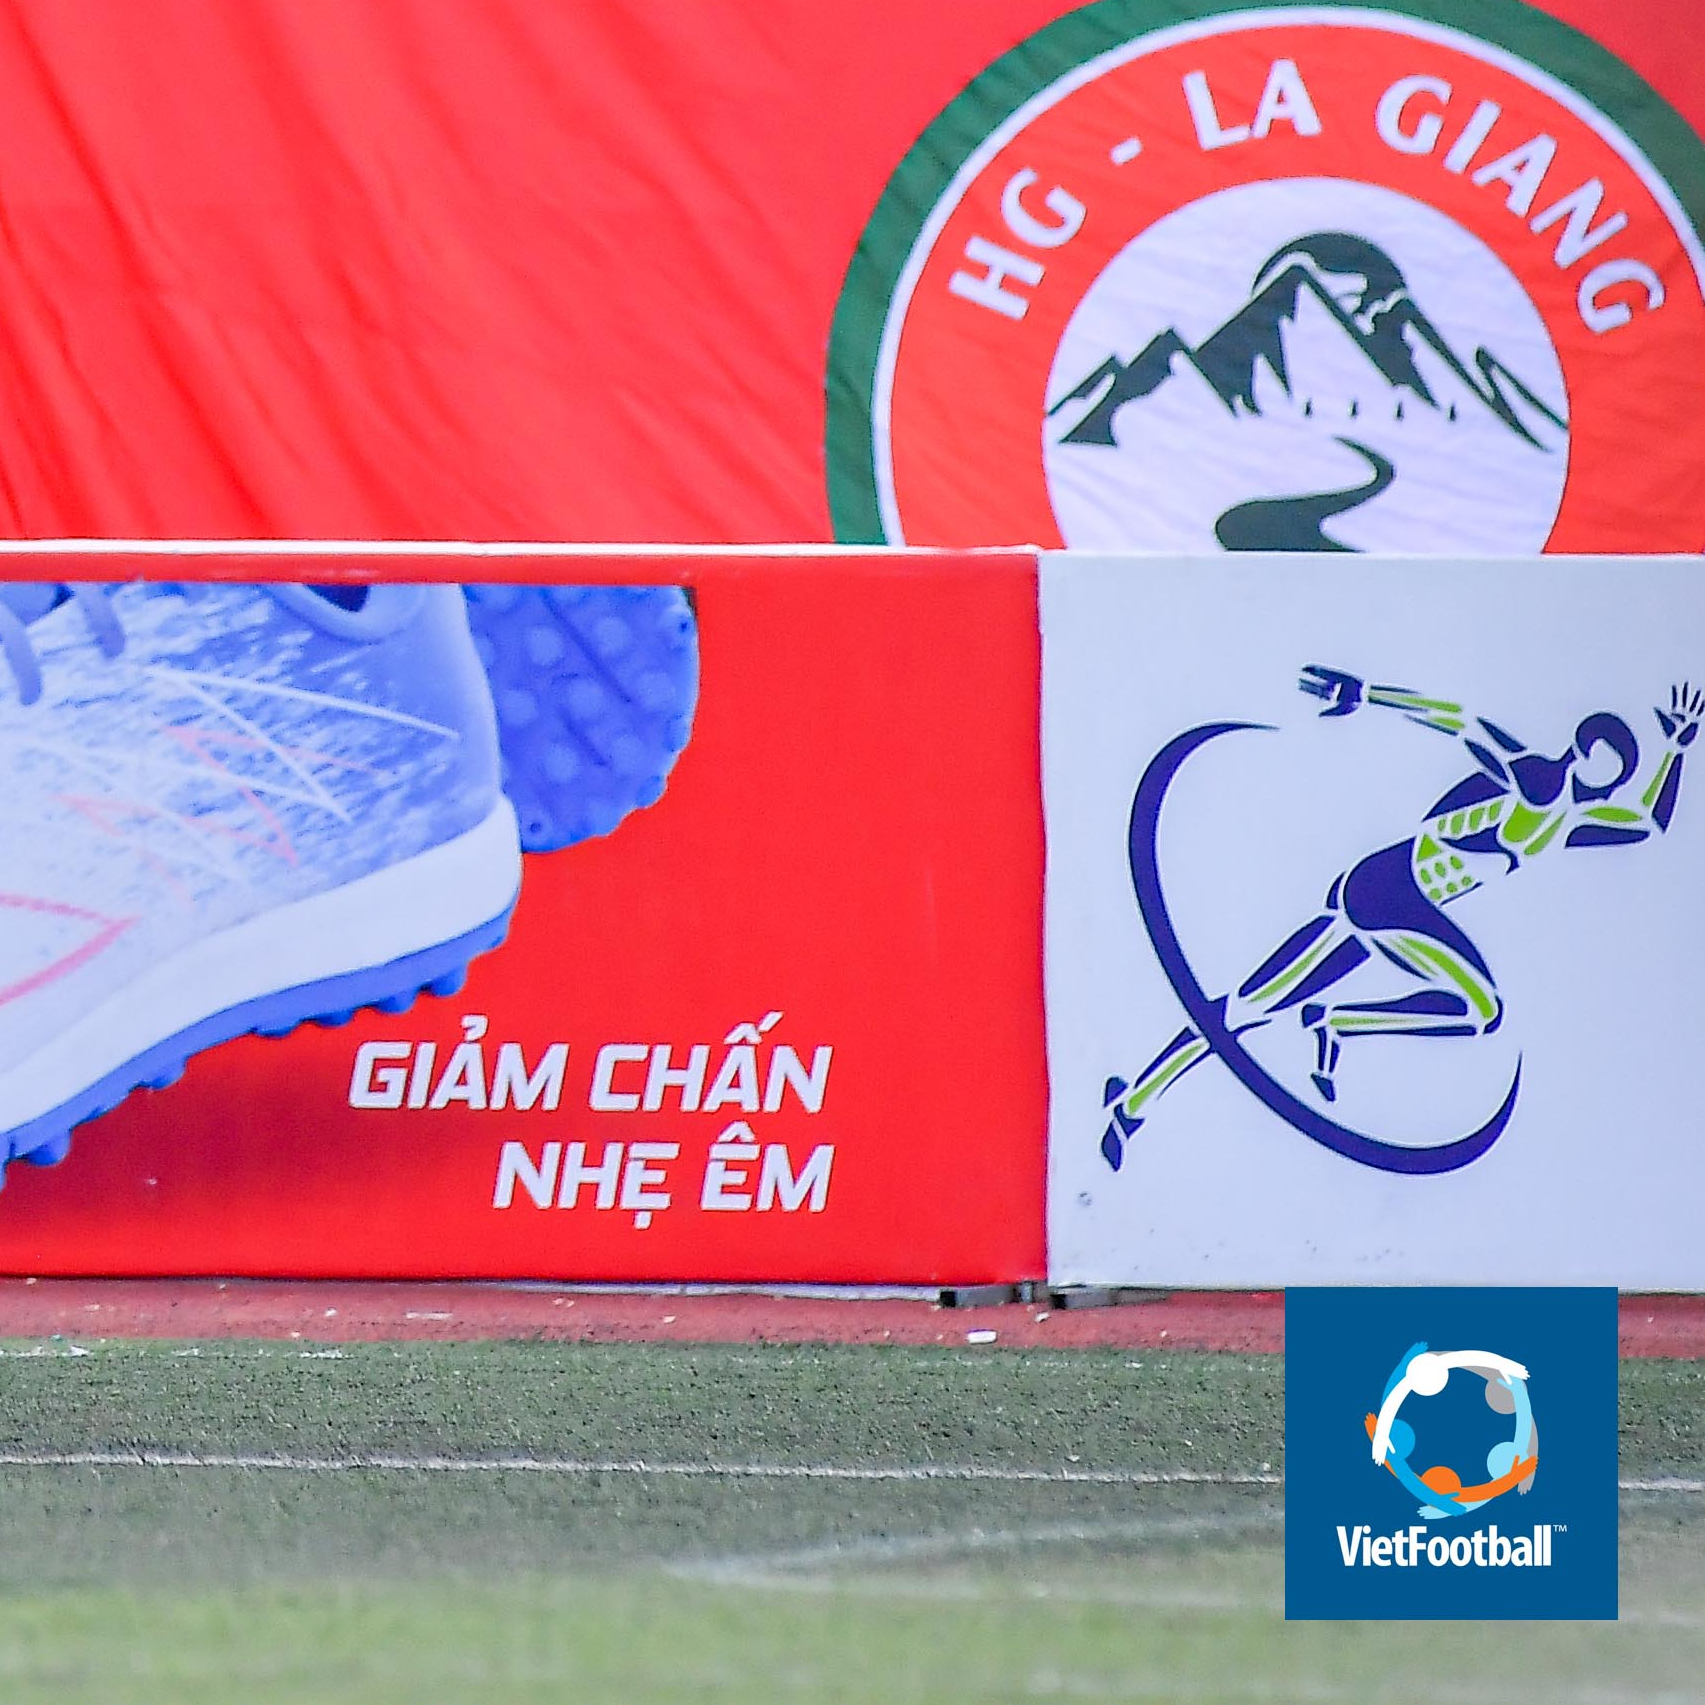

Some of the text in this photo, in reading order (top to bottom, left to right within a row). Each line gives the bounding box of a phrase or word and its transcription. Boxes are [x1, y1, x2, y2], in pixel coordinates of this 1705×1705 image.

[948, 166, 1087, 322] HG
[1182, 57, 1323, 151] LA
[1375, 73, 1666, 335] GIANG
[348, 1011, 834, 1114] GIẢM CHẤN
[492, 1120, 836, 1230] NHẸ ÊM
